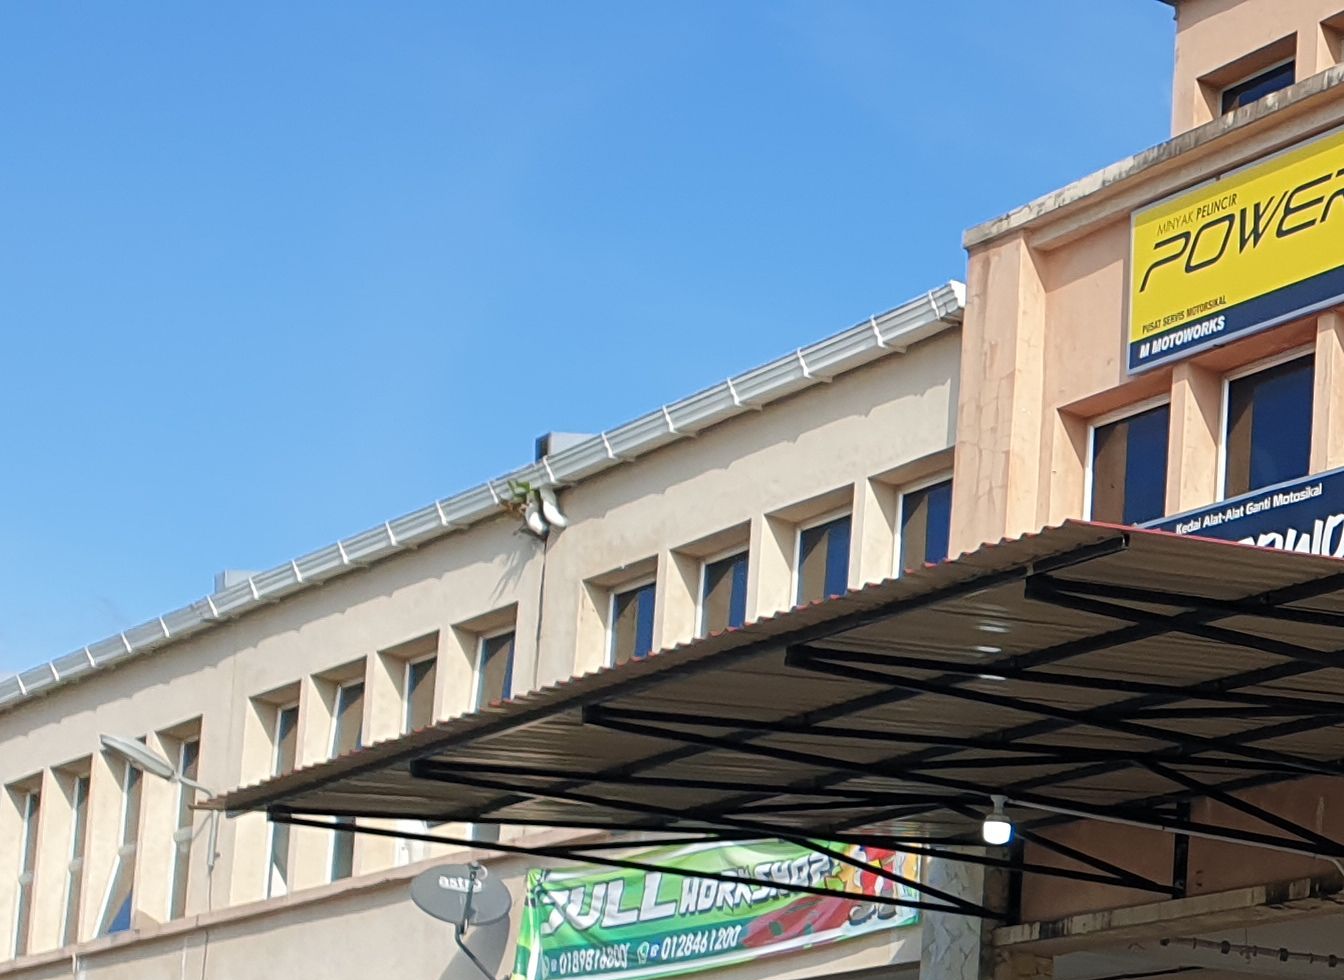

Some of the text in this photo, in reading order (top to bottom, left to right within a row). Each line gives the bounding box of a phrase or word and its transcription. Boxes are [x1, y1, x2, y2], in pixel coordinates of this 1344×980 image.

[1157, 193, 1238, 236] MINYAK PELINCIR
[1139, 315, 1226, 359] M MOTOWORKS
[1142, 319, 1161, 335] PUSAT
[1162, 309, 1185, 327] SERVIS
[1176, 483, 1322, 534] Kedai Alat-Alat Ganti Motosikal
